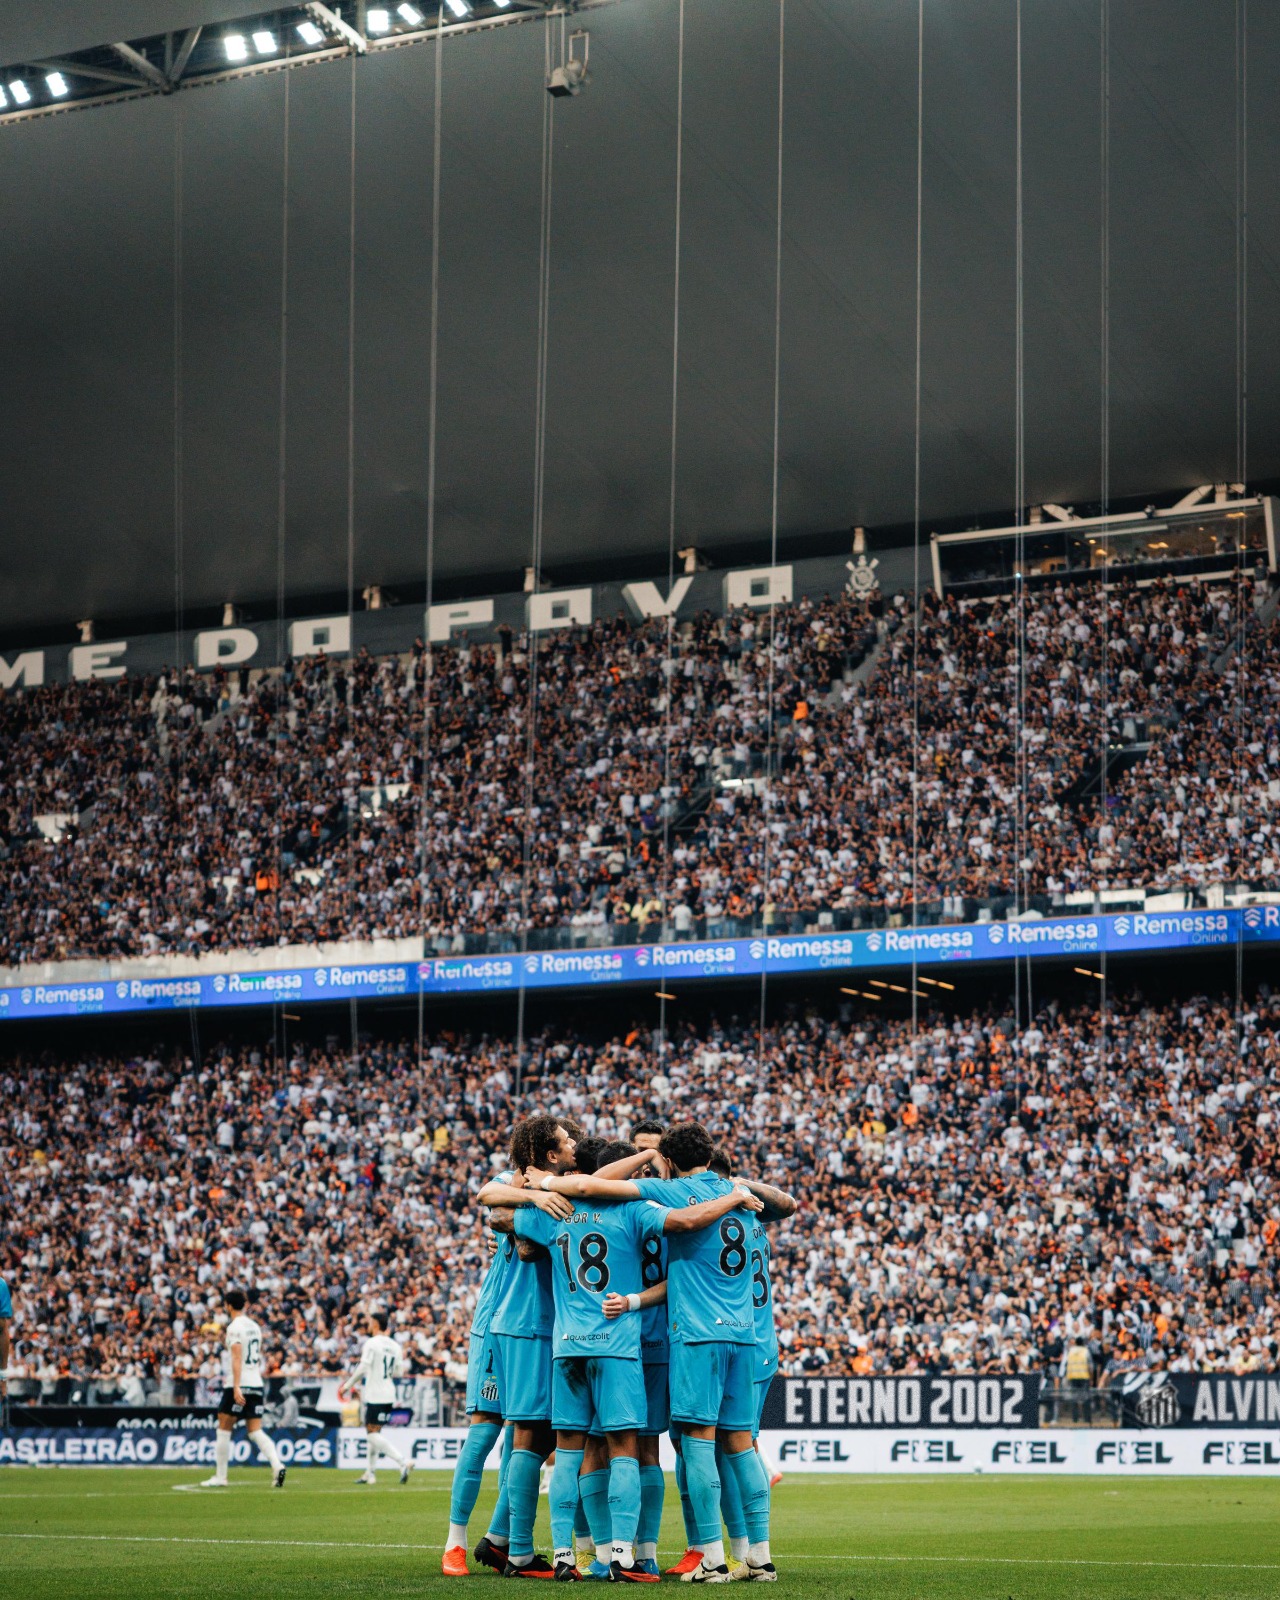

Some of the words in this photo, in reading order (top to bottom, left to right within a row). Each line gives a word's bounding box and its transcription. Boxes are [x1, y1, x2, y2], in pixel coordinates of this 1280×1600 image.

[194, 616, 350, 667] DO
[426, 565, 793, 642] POVO
[1008, 923, 1098, 944] Remessa
[1134, 914, 1228, 935] Remessa
[885, 931, 973, 951] Remessa
[1063, 939, 1097, 952] Online
[1192, 932, 1228, 944] Online
[653, 946, 736, 966] Remessa
[767, 939, 853, 959] Remessa
[542, 954, 622, 973] Remessa
[820, 956, 852, 967] Online
[330, 967, 406, 986] Remessa
[35, 986, 104, 1004] Remessa
[131, 981, 201, 998] Remessa
[719, 1216, 747, 1278] 8
[556, 1232, 610, 1293] 18
[569, 1331, 610, 1344] quartzolit
[785, 1379, 921, 1423] ETERNO
[930, 1379, 1024, 1423] 2002
[779, 1439, 850, 1462] FIEL
[891, 1440, 964, 1463] FIEL
[992, 1440, 1068, 1463] FIEL
[1096, 1441, 1173, 1464] FIEL
[555, 1550, 572, 1559] PRO
